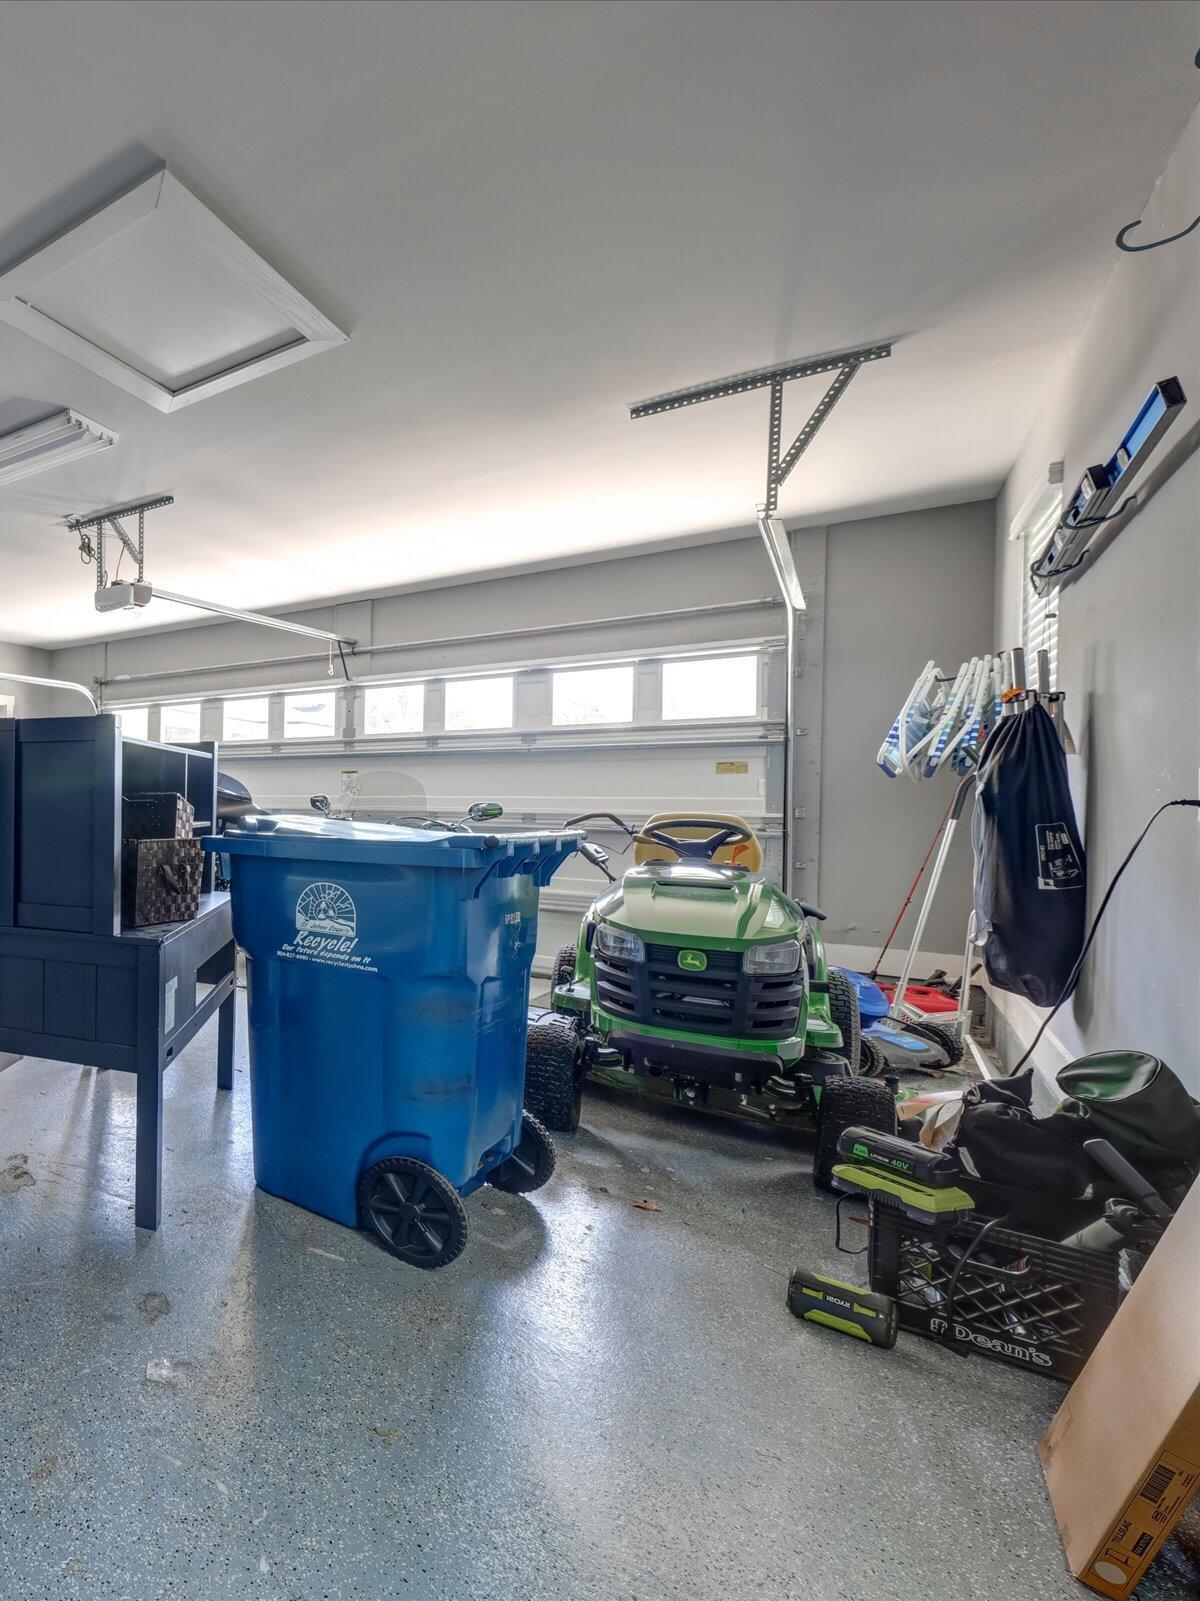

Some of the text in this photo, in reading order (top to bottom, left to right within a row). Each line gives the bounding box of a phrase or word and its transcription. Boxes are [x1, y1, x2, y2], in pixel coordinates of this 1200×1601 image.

[293, 930, 359, 953] Recycle!
[282, 943, 296, 951] Our
[296, 946, 318, 955] future
[319, 950, 349, 961] depends
[891, 1159, 910, 1170] 40V
[825, 1295, 851, 1309] RYOBI
[952, 1323, 1053, 1367] Dean's
